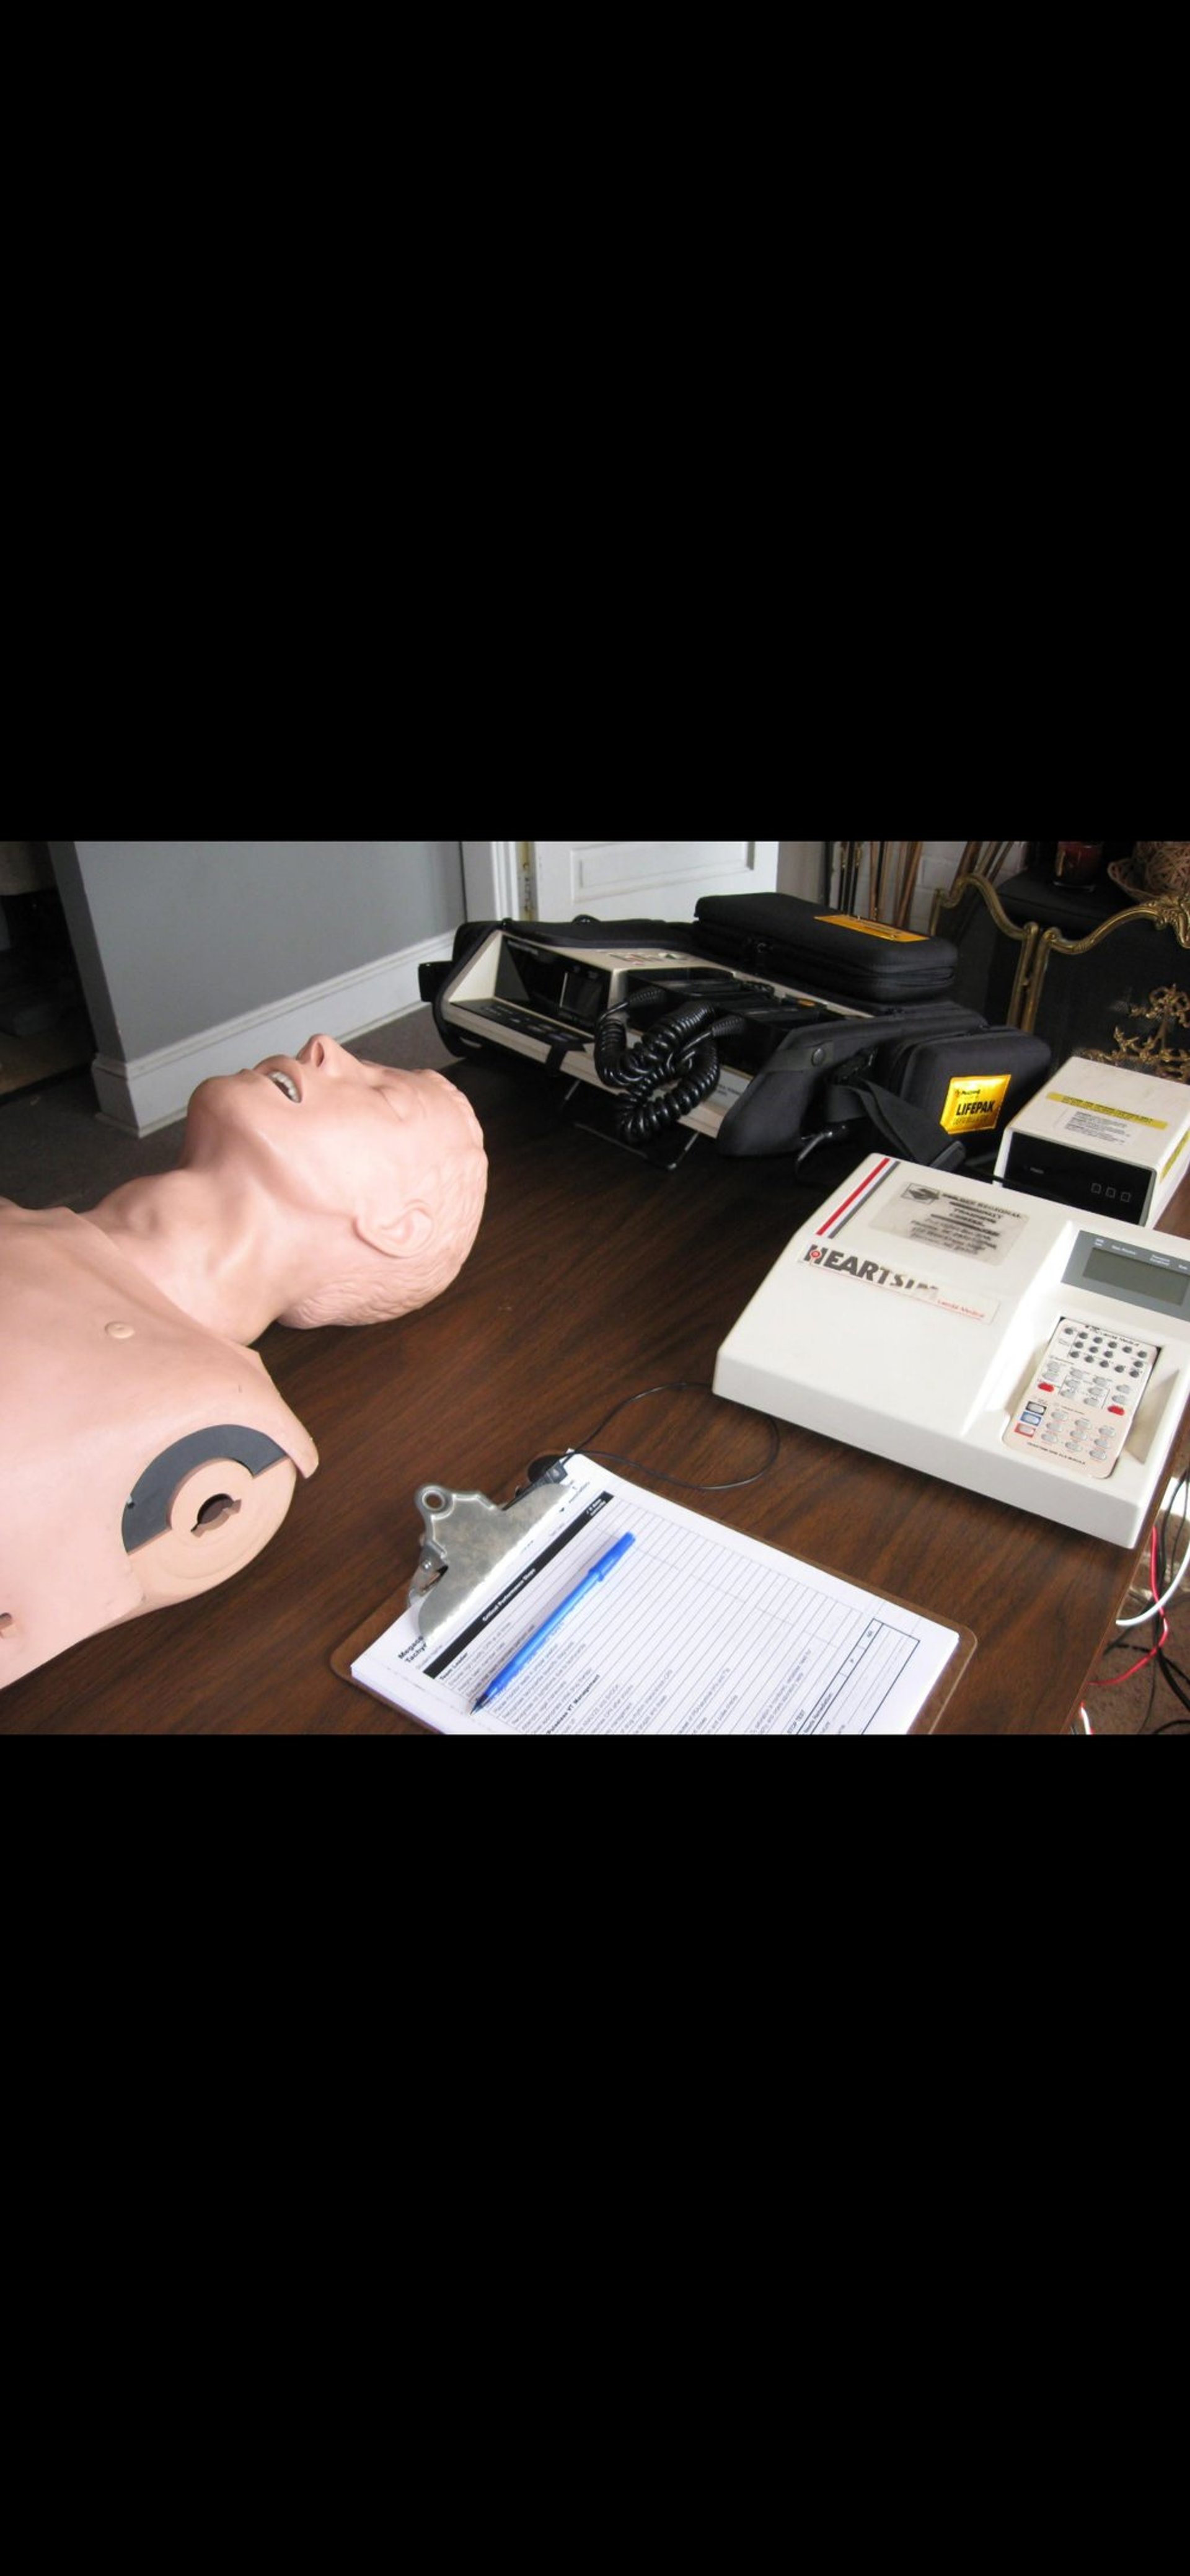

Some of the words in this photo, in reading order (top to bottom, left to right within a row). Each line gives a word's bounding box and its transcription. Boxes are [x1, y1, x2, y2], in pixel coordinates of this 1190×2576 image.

[956, 1100, 995, 1115] LIFEPAK
[481, 1604, 500, 1622] Critical
[496, 1579, 525, 1606] Performance
[522, 1567, 536, 1580] Steps
[439, 1668, 452, 1680] Team
[451, 1652, 469, 1668] Leader
[573, 1674, 601, 1704] Management
